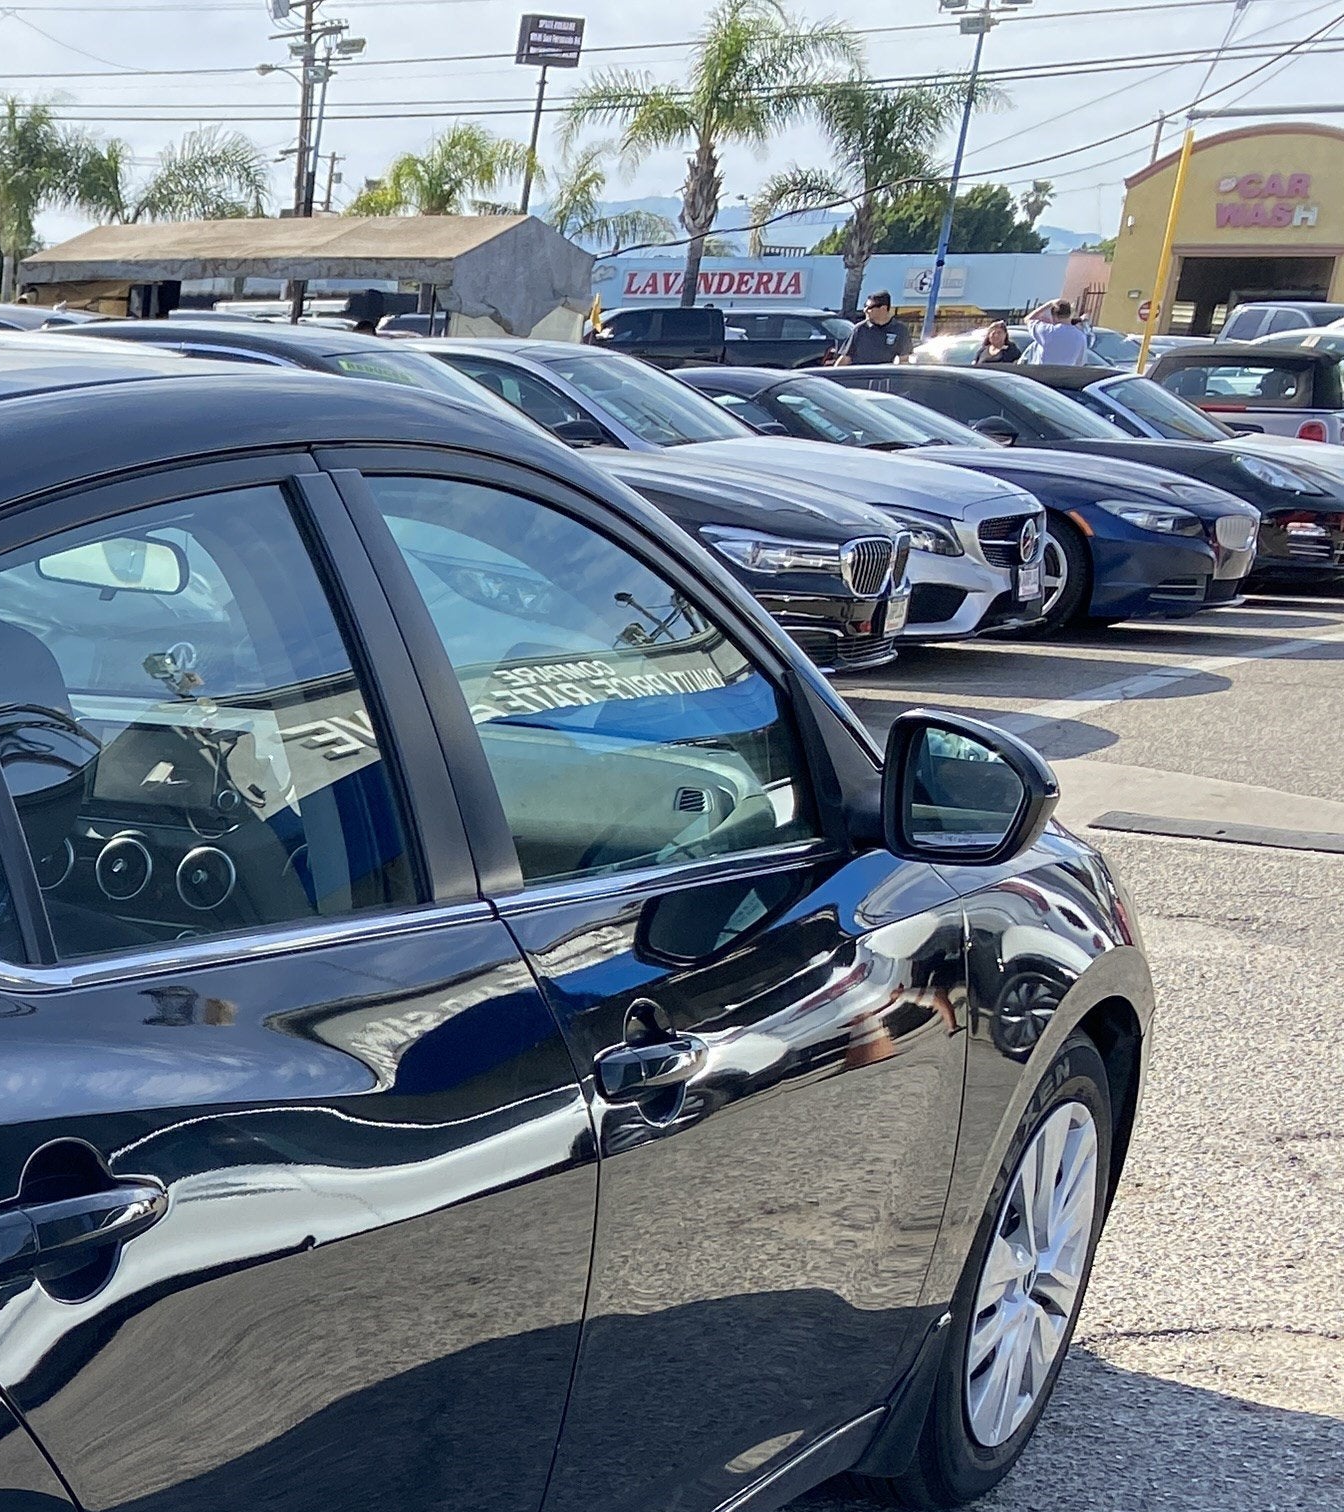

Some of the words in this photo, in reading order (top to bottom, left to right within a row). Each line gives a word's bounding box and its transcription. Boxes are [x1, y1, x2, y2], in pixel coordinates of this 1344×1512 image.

[1237, 173, 1311, 199] CAR
[1215, 202, 1319, 228] WASH
[624, 271, 802, 295] LAVNDERIA
